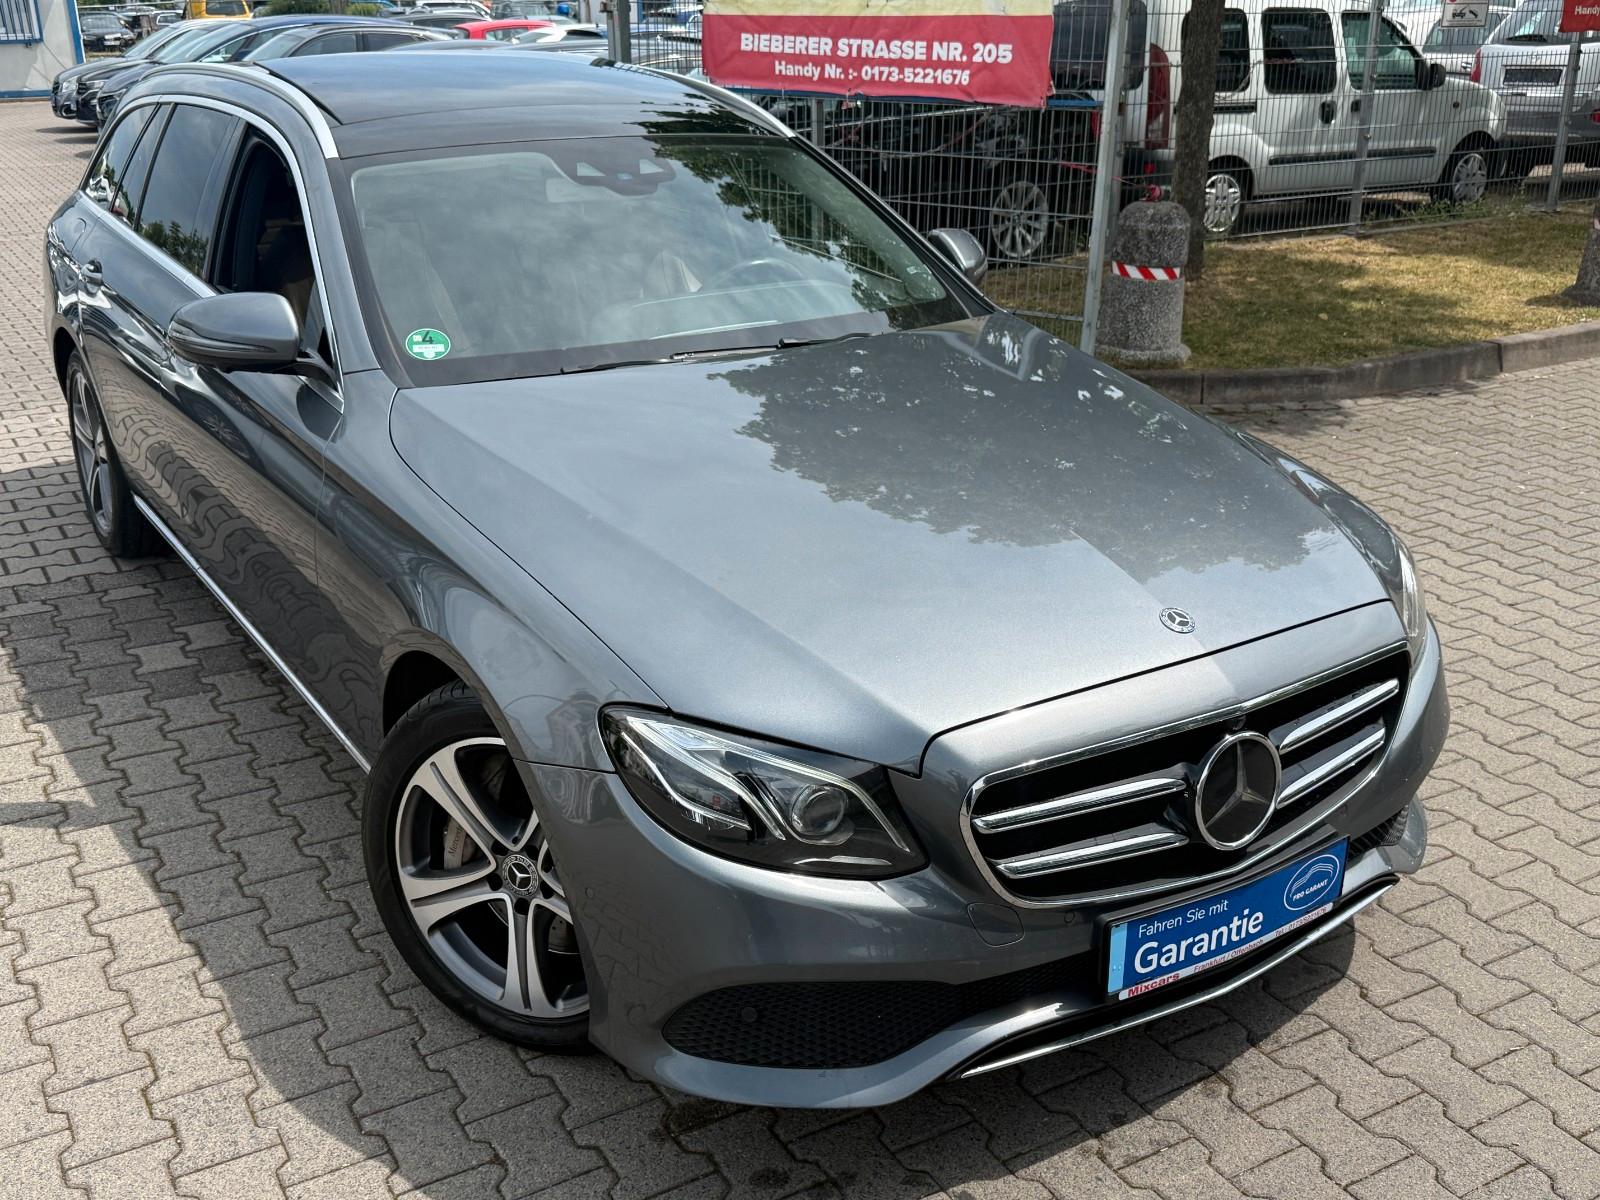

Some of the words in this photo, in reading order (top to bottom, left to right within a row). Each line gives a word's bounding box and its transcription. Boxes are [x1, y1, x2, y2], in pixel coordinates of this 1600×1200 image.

[740, 32, 833, 56] BIEBERER
[836, 38, 928, 60] STRASSE
[932, 41, 967, 62] NR.
[972, 42, 1013, 64] 205
[774, 60, 820, 81] Handy
[824, 63, 844, 79] Nr.
[861, 65, 970, 86] 0173-5221676
[422, 330, 433, 344] 4
[1292, 890, 1305, 902] PRO
[1305, 879, 1329, 895] GARANT
[1138, 916, 1183, 938] Fahren
[1186, 907, 1206, 924] Sie
[1208, 899, 1229, 917] mit
[1134, 908, 1264, 974] Garantie
[1127, 972, 1180, 998] Mixcars
[1193, 955, 1226, 973] Frankfurt
[1230, 939, 1264, 958] Offenbach
